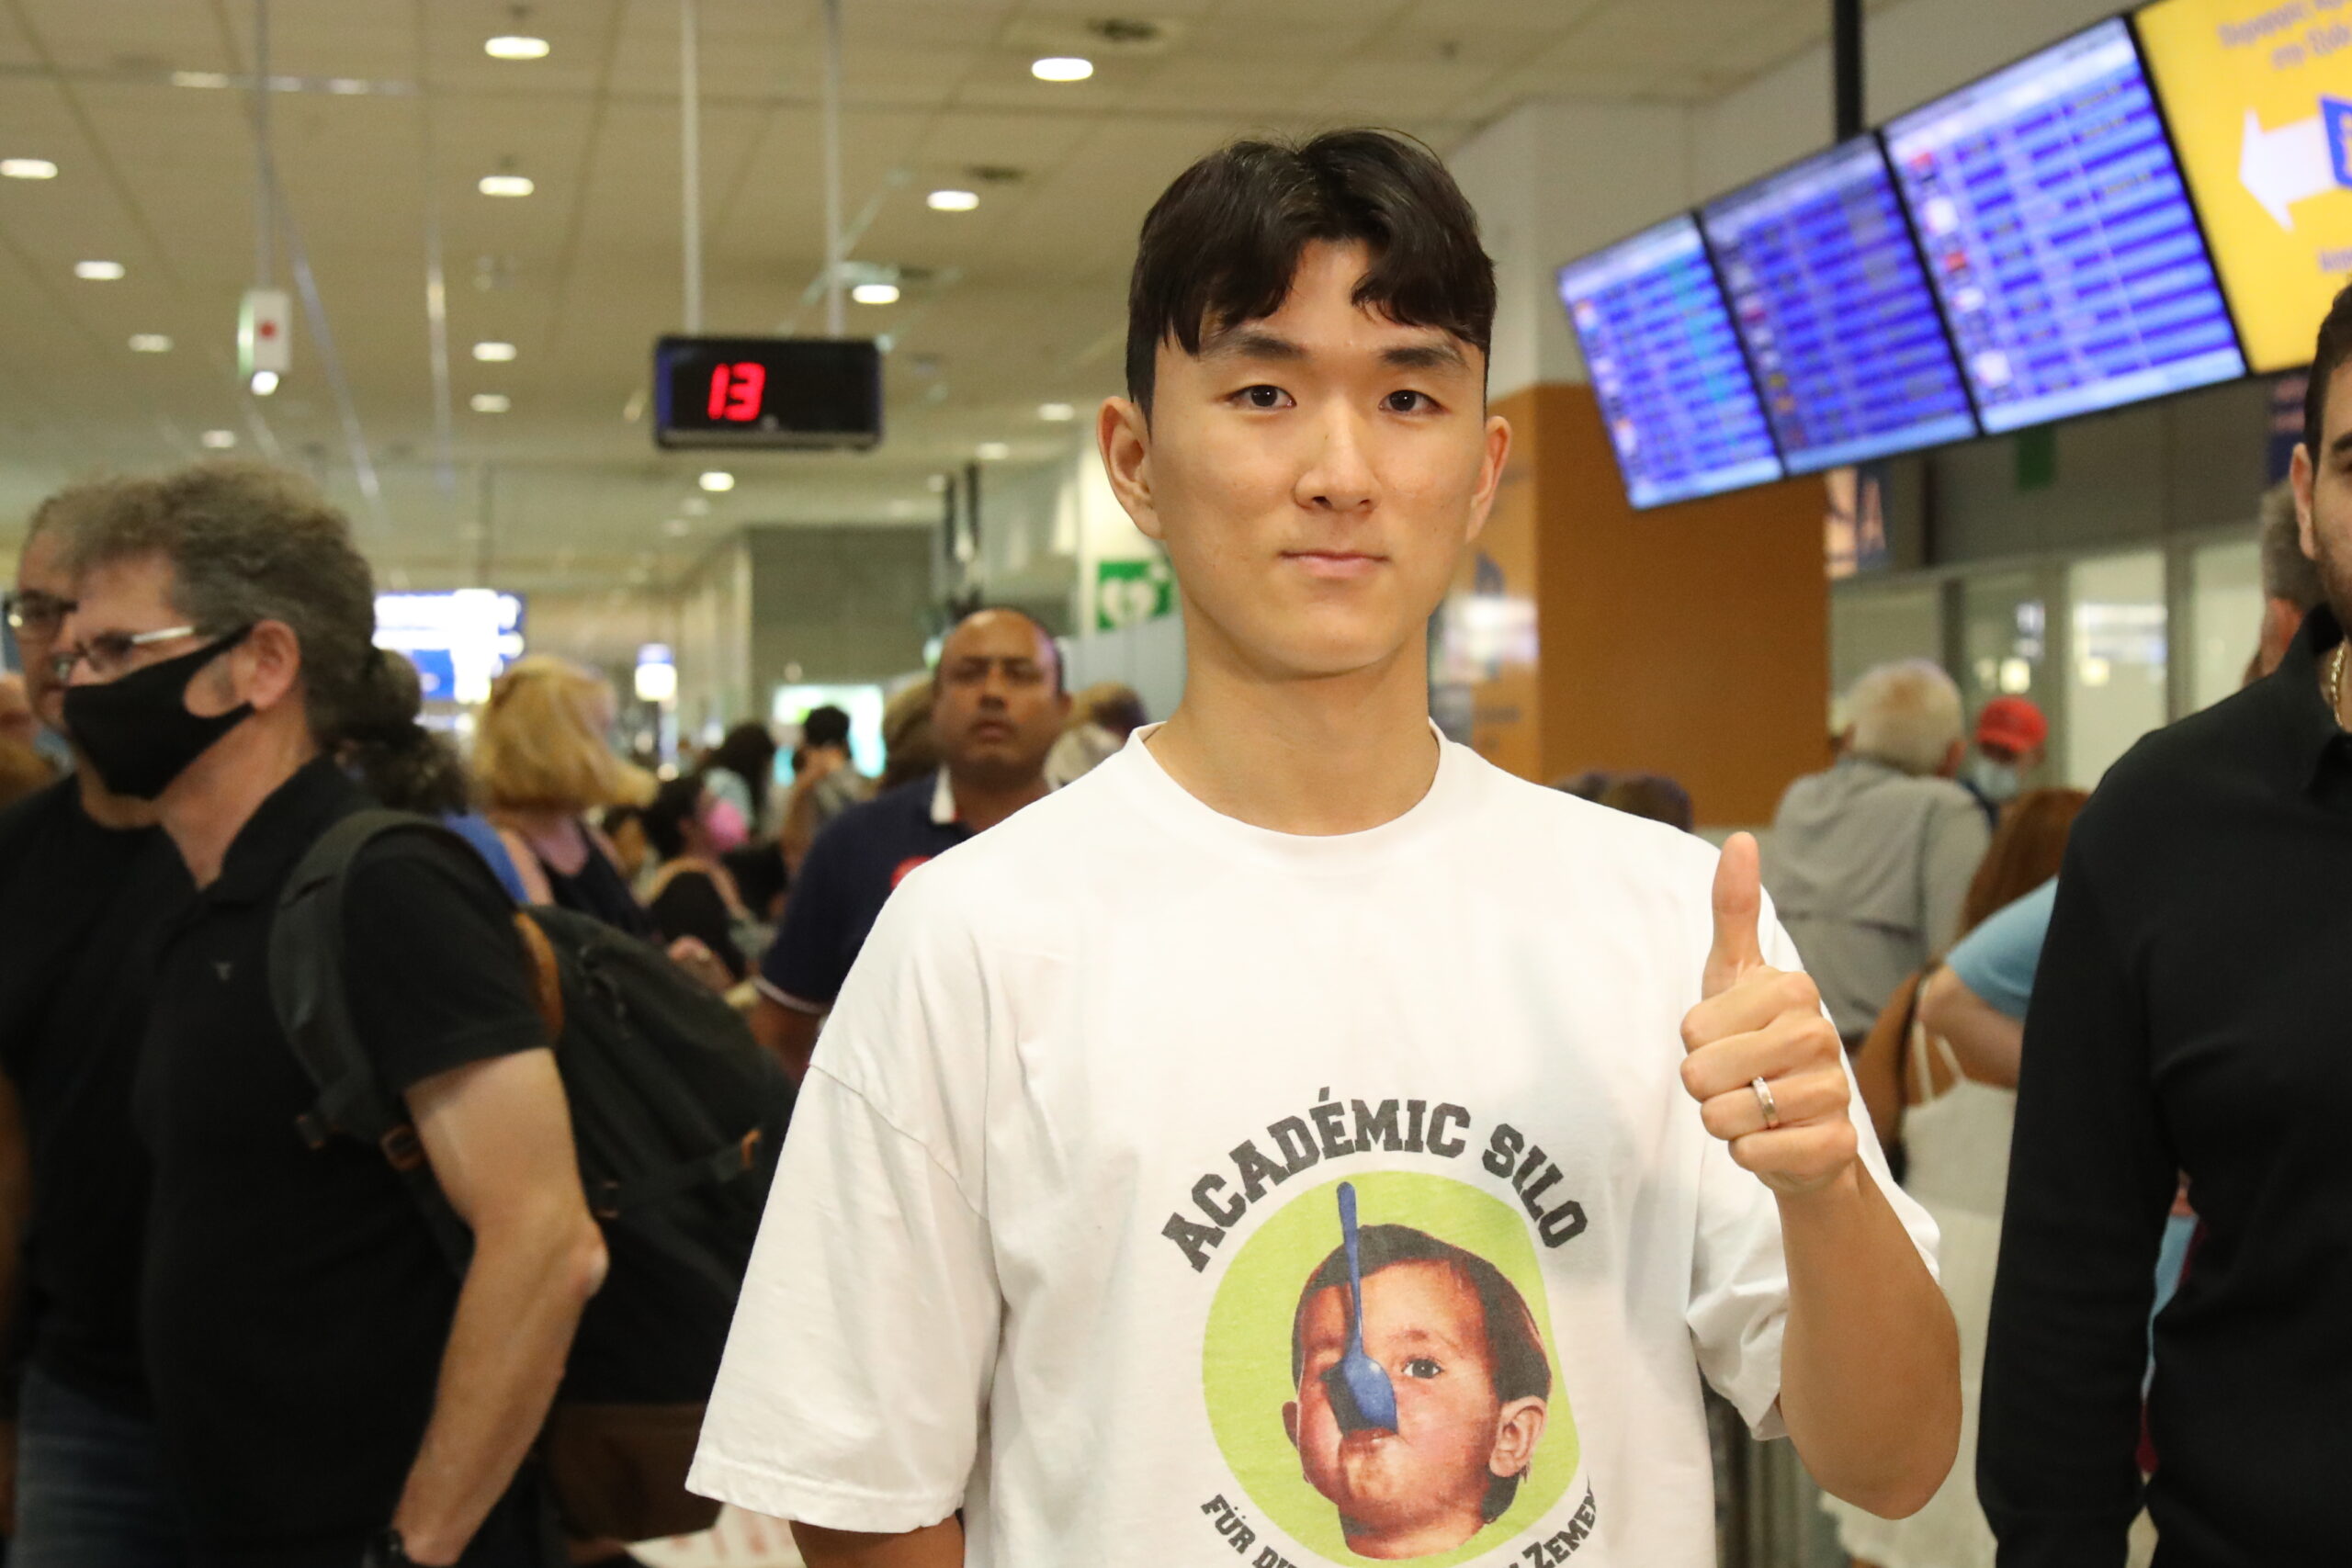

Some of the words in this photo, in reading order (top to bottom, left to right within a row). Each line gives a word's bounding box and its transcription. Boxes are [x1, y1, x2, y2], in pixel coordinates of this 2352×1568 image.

[707, 362, 766, 423] 13
[1161, 1086, 1471, 1273] ACADÉMIC
[1200, 1494, 1256, 1554] FÜR
